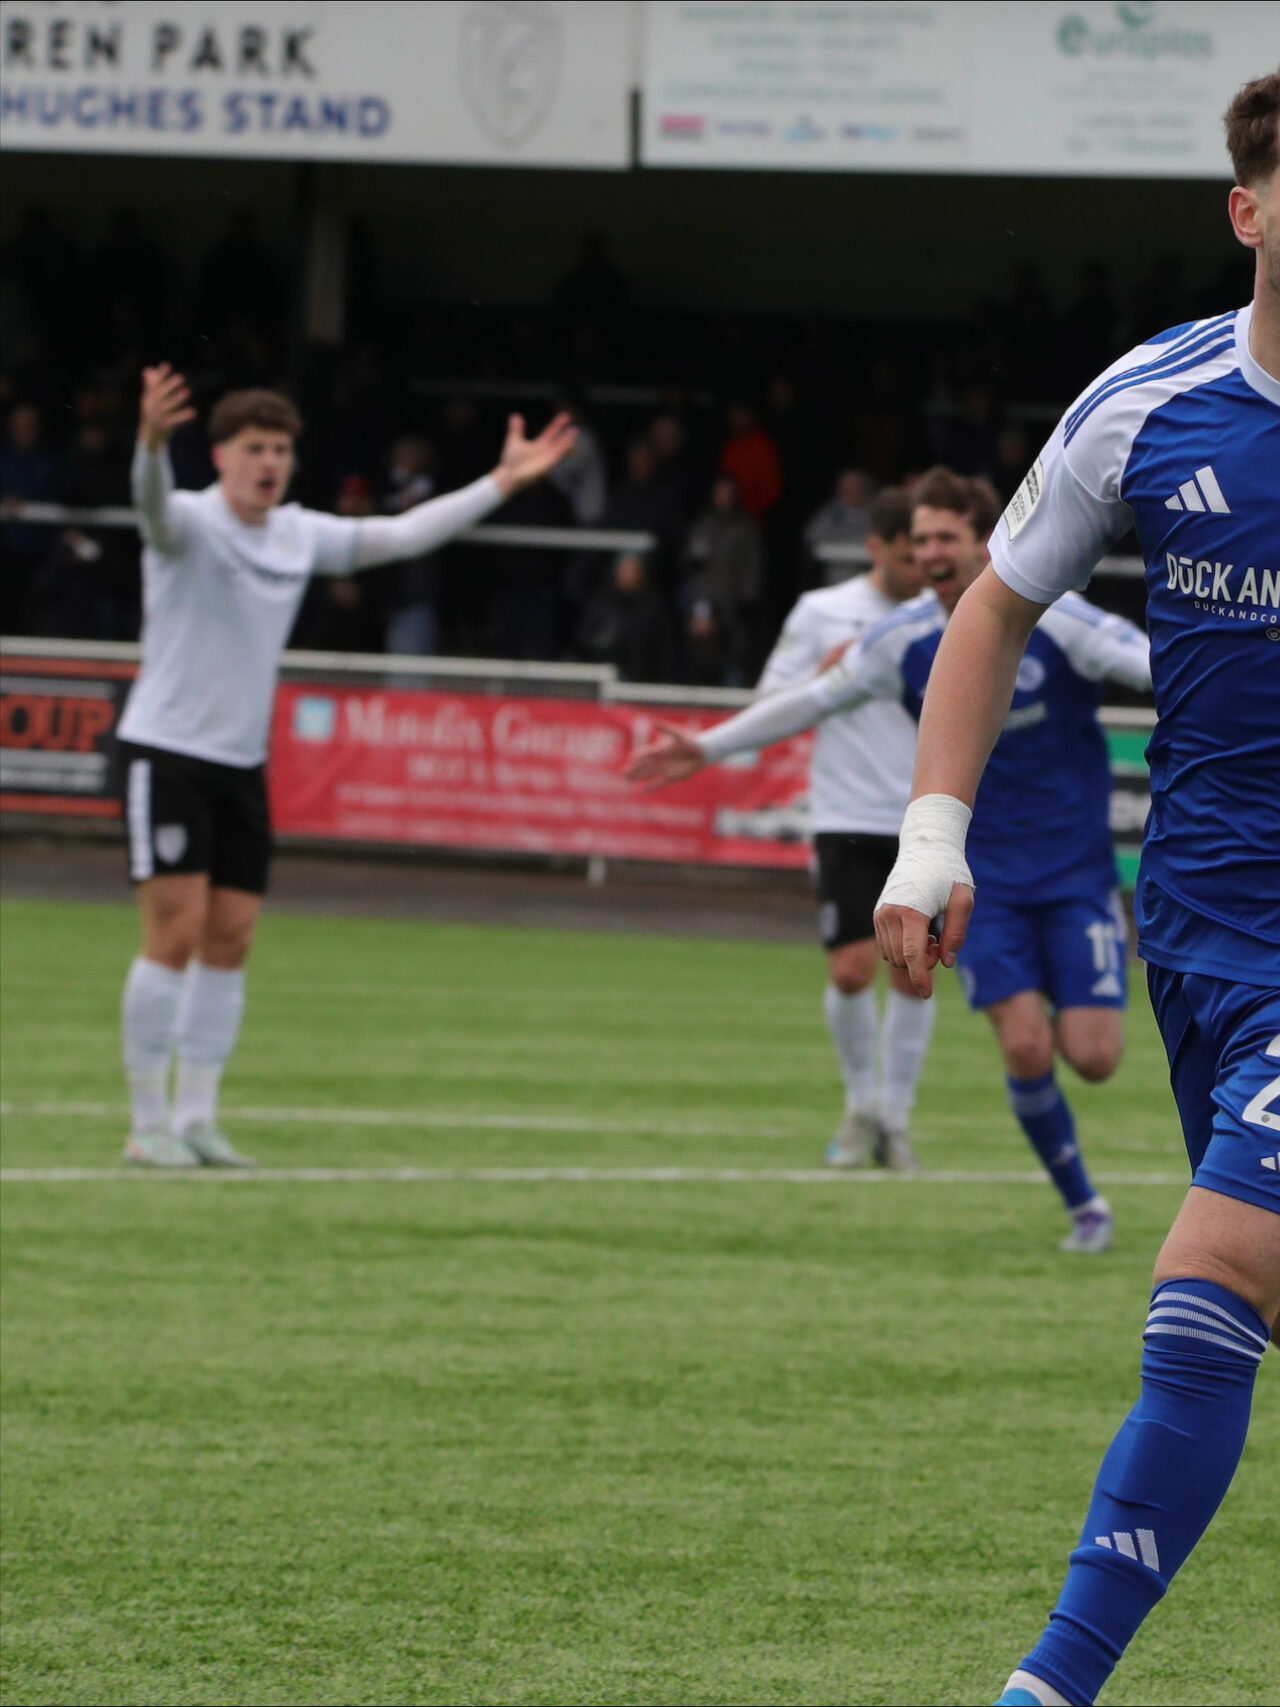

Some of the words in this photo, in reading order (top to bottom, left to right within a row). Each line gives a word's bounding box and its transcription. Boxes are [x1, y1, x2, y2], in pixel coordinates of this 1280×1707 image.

[7, 18, 122, 72] REN
[153, 23, 315, 78] PARK
[1, 84, 204, 132] HUGHES
[222, 93, 392, 138] STAND
[1165, 552, 1234, 602] DUCK
